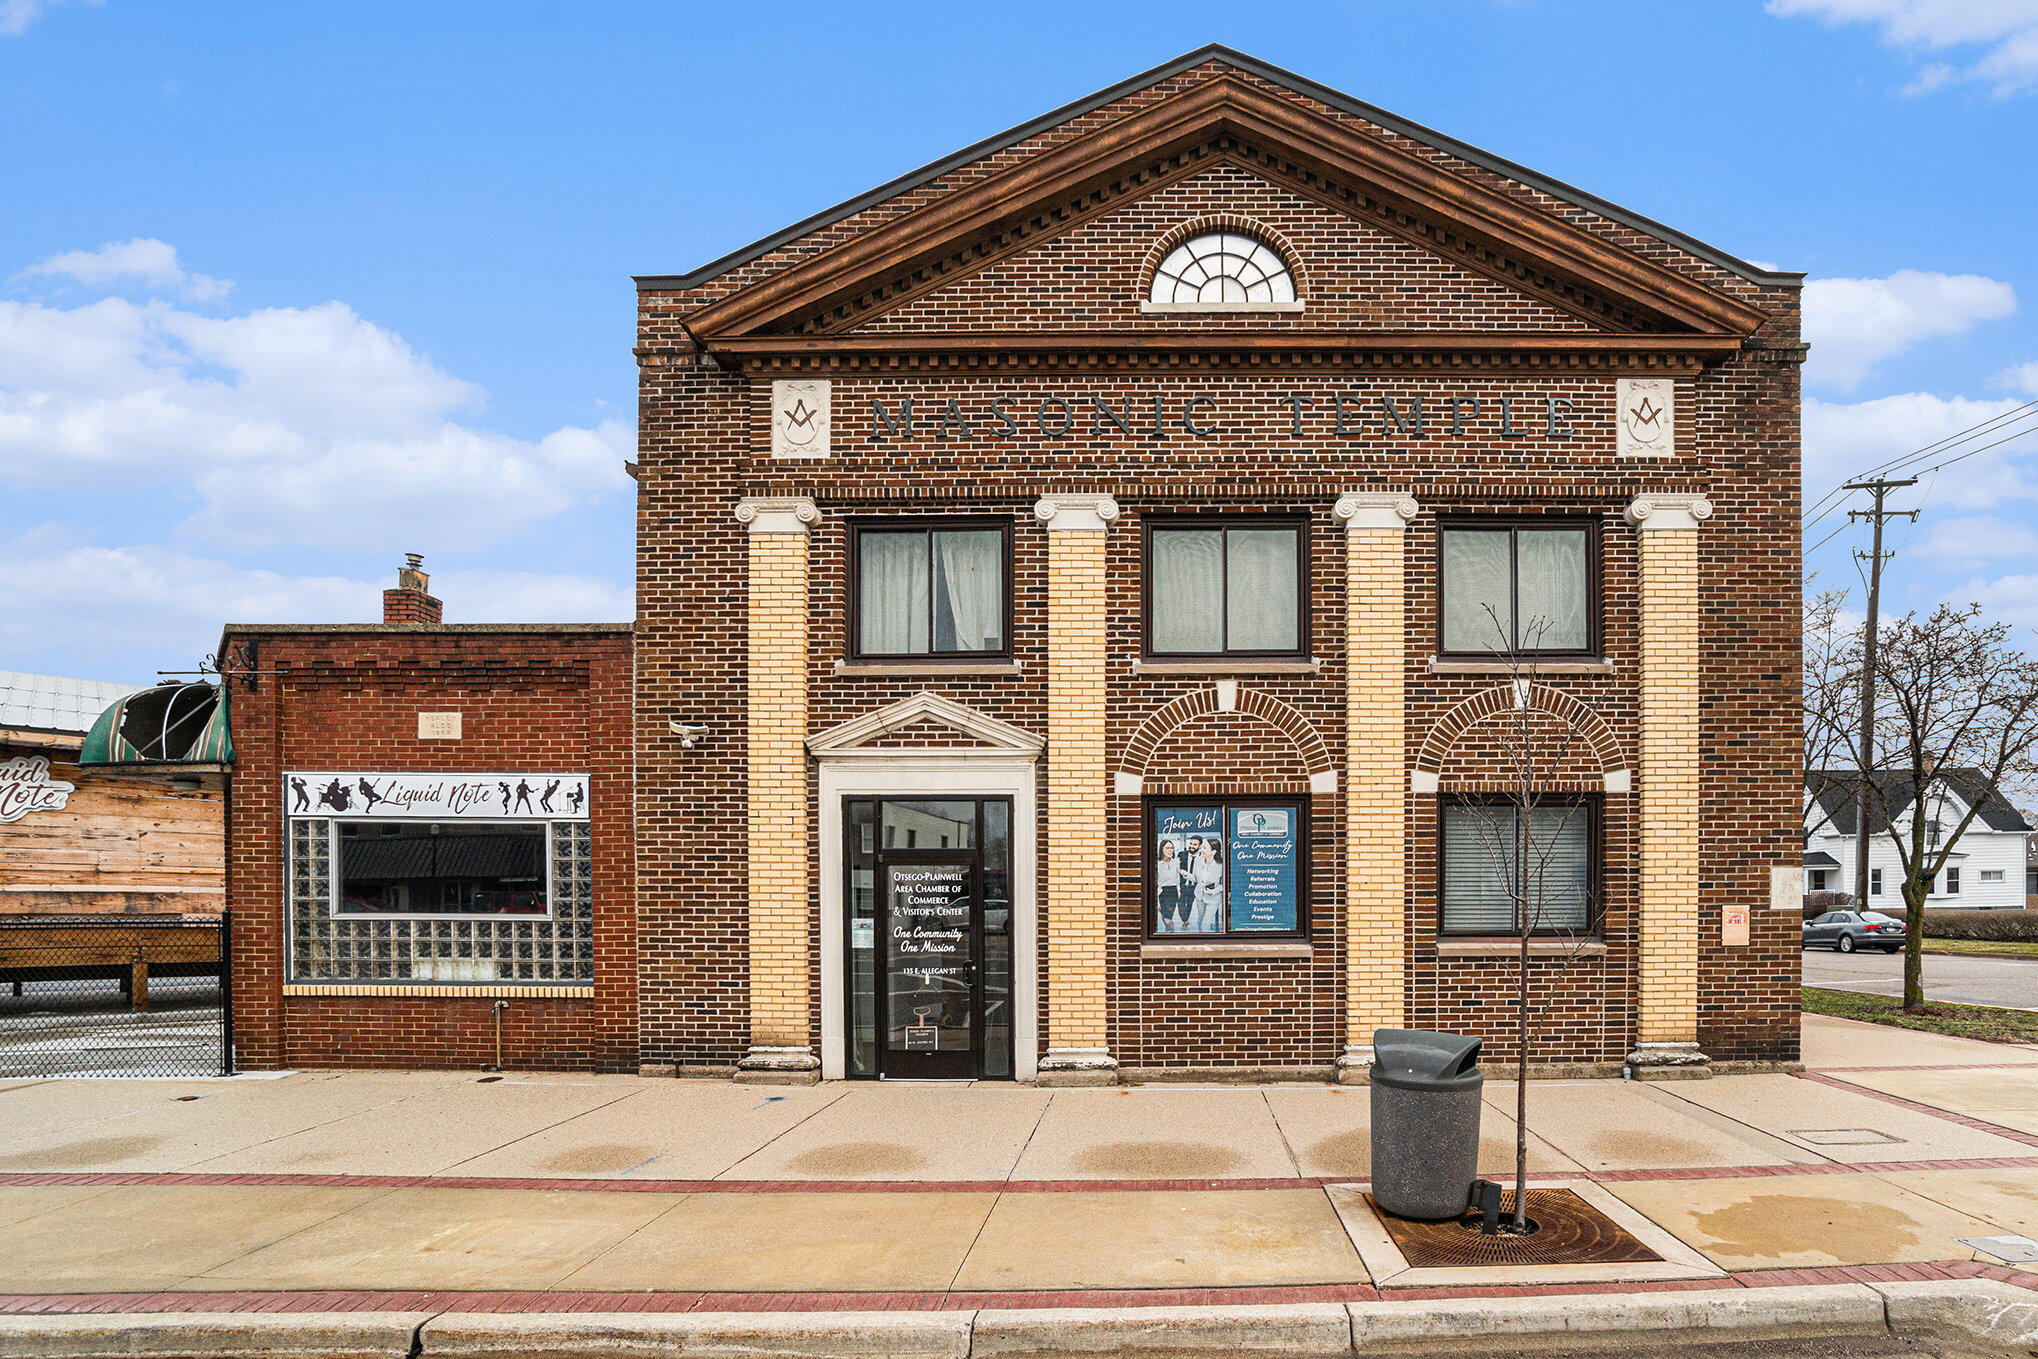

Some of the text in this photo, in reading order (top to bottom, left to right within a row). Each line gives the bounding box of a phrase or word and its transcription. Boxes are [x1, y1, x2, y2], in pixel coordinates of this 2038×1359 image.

[870, 396, 1576, 438] MASONIC TEMPLE
[380, 780, 496, 814] Liquid Note
[1162, 810, 1217, 837] Join Us!
[1232, 839, 1293, 854] One Community
[1237, 851, 1289, 860] One Mission
[893, 871, 963, 881] OTSEGO-PLAINWELL
[894, 883, 962, 893] AREA CHAMBER OF
[907, 895, 949, 905] COMMERCE
[893, 906, 902, 918] &
[936, 906, 963, 916] CENTER
[893, 926, 963, 942] One Community
[900, 940, 956, 952] One Mission
[921, 967, 948, 975] ALLEGAN
[949, 967, 956, 975] ST
